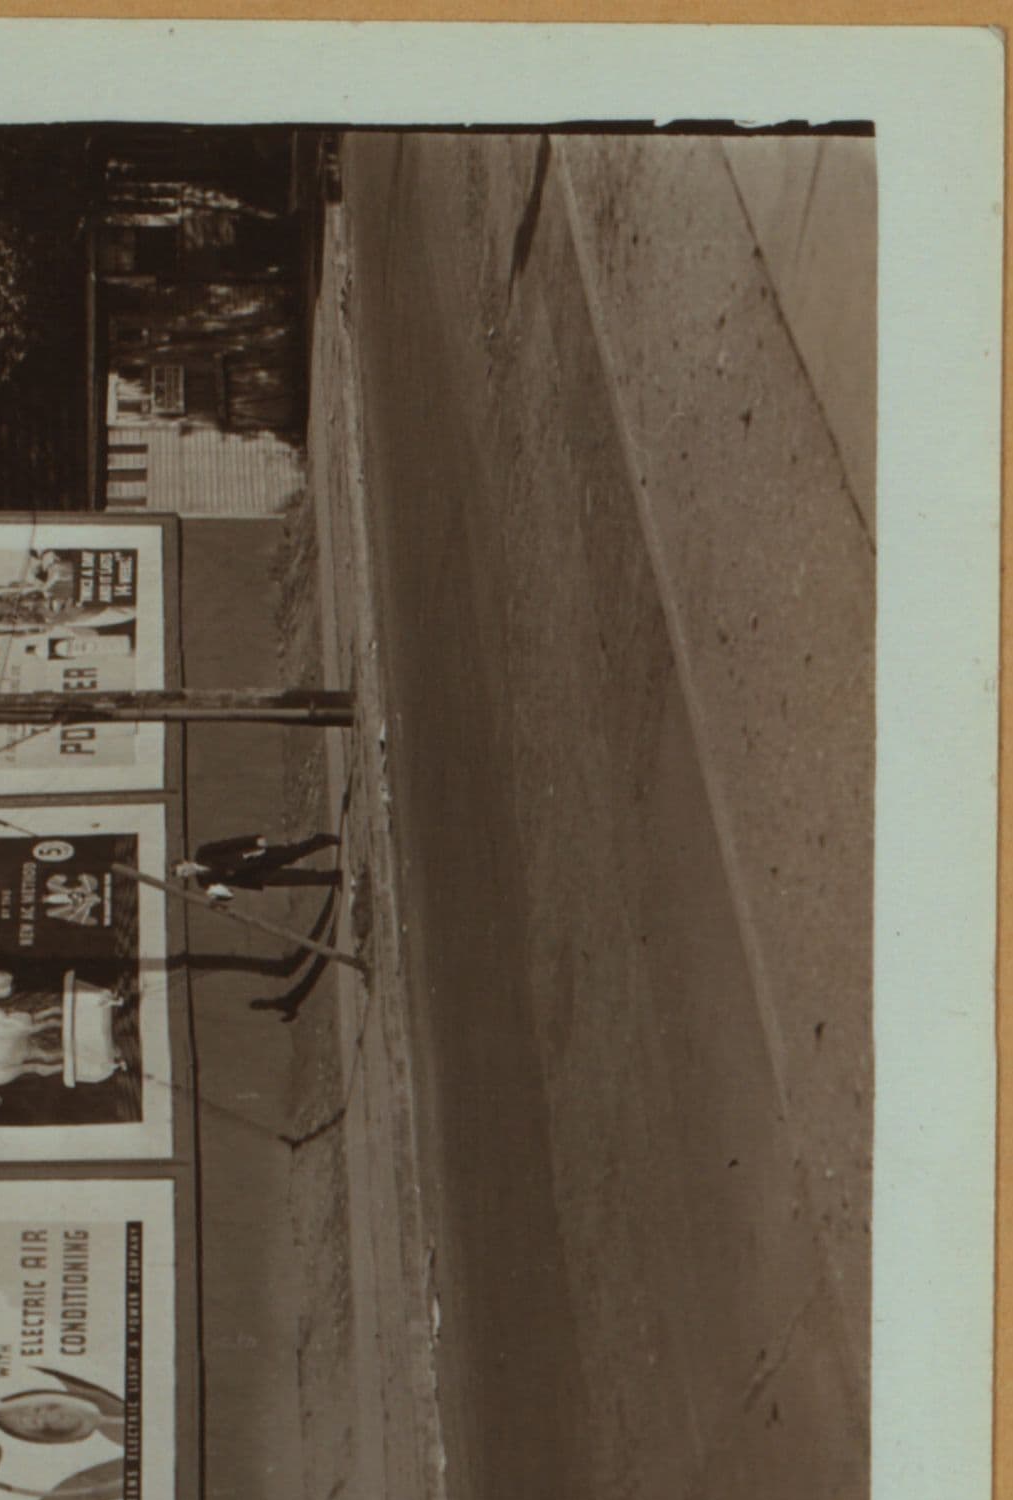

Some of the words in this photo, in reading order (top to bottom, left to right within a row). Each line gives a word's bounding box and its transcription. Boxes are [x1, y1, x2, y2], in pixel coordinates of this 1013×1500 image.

[19, 924, 34, 946] NEW
[20, 1229, 47, 1269] AIR
[128, 1227, 140, 1284] COMPANY
[20, 1280, 45, 1356] ELECTRIC
[59, 1229, 89, 1356] CONDITIONING
[128, 1292, 140, 1333] POWER
[126, 1402, 139, 1460] ELECTRIC
